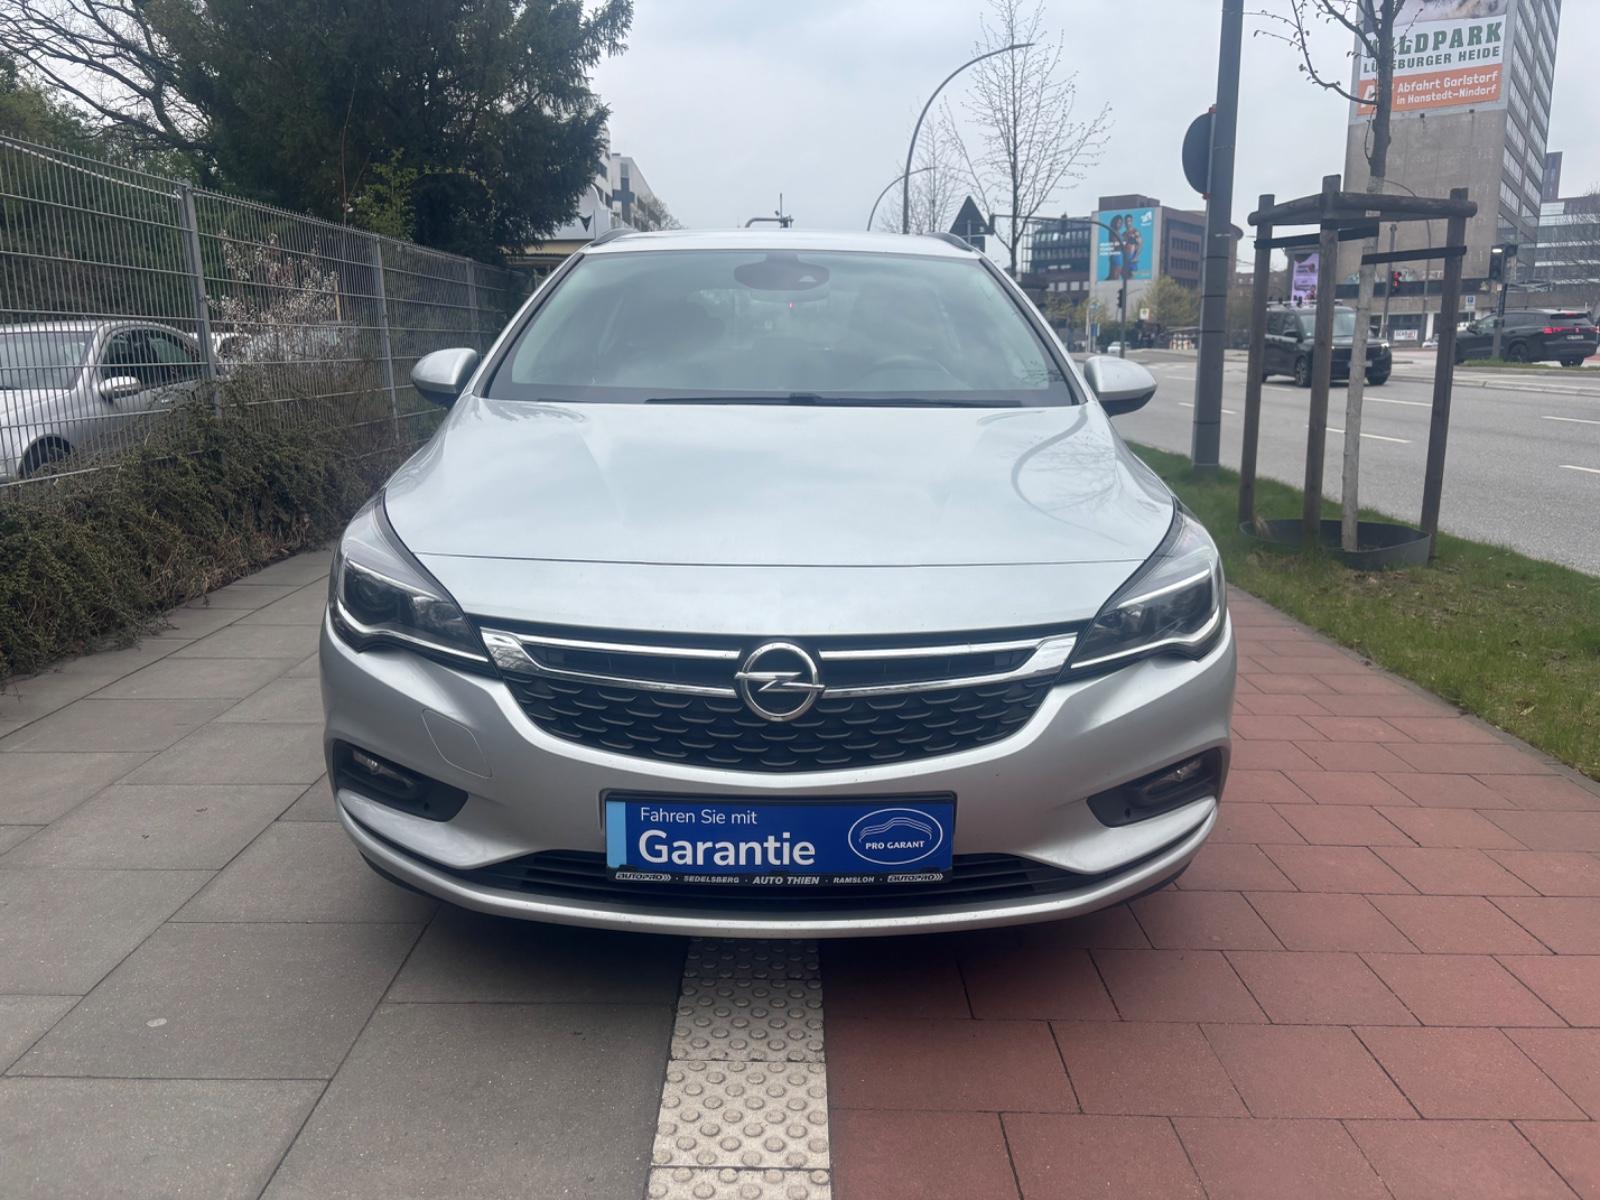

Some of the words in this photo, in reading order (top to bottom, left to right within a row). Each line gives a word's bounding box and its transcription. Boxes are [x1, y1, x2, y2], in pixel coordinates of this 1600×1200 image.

[1458, 46, 1500, 62] HEIDE
[1397, 79, 1441, 94] Abfahrt
[1443, 70, 1499, 88] Garlstorf
[1397, 95, 1406, 105] in
[1407, 84, 1497, 104] Hanstedt-Nindorf
[640, 807, 696, 824] Fahren
[701, 809, 726, 825] Sie
[731, 810, 758, 825] mit
[638, 829, 816, 866] Garantie
[865, 841, 885, 850] PRO
[887, 840, 925, 850] GARANT
[752, 876, 784, 885] AUTO
[786, 876, 820, 885] THIEN
